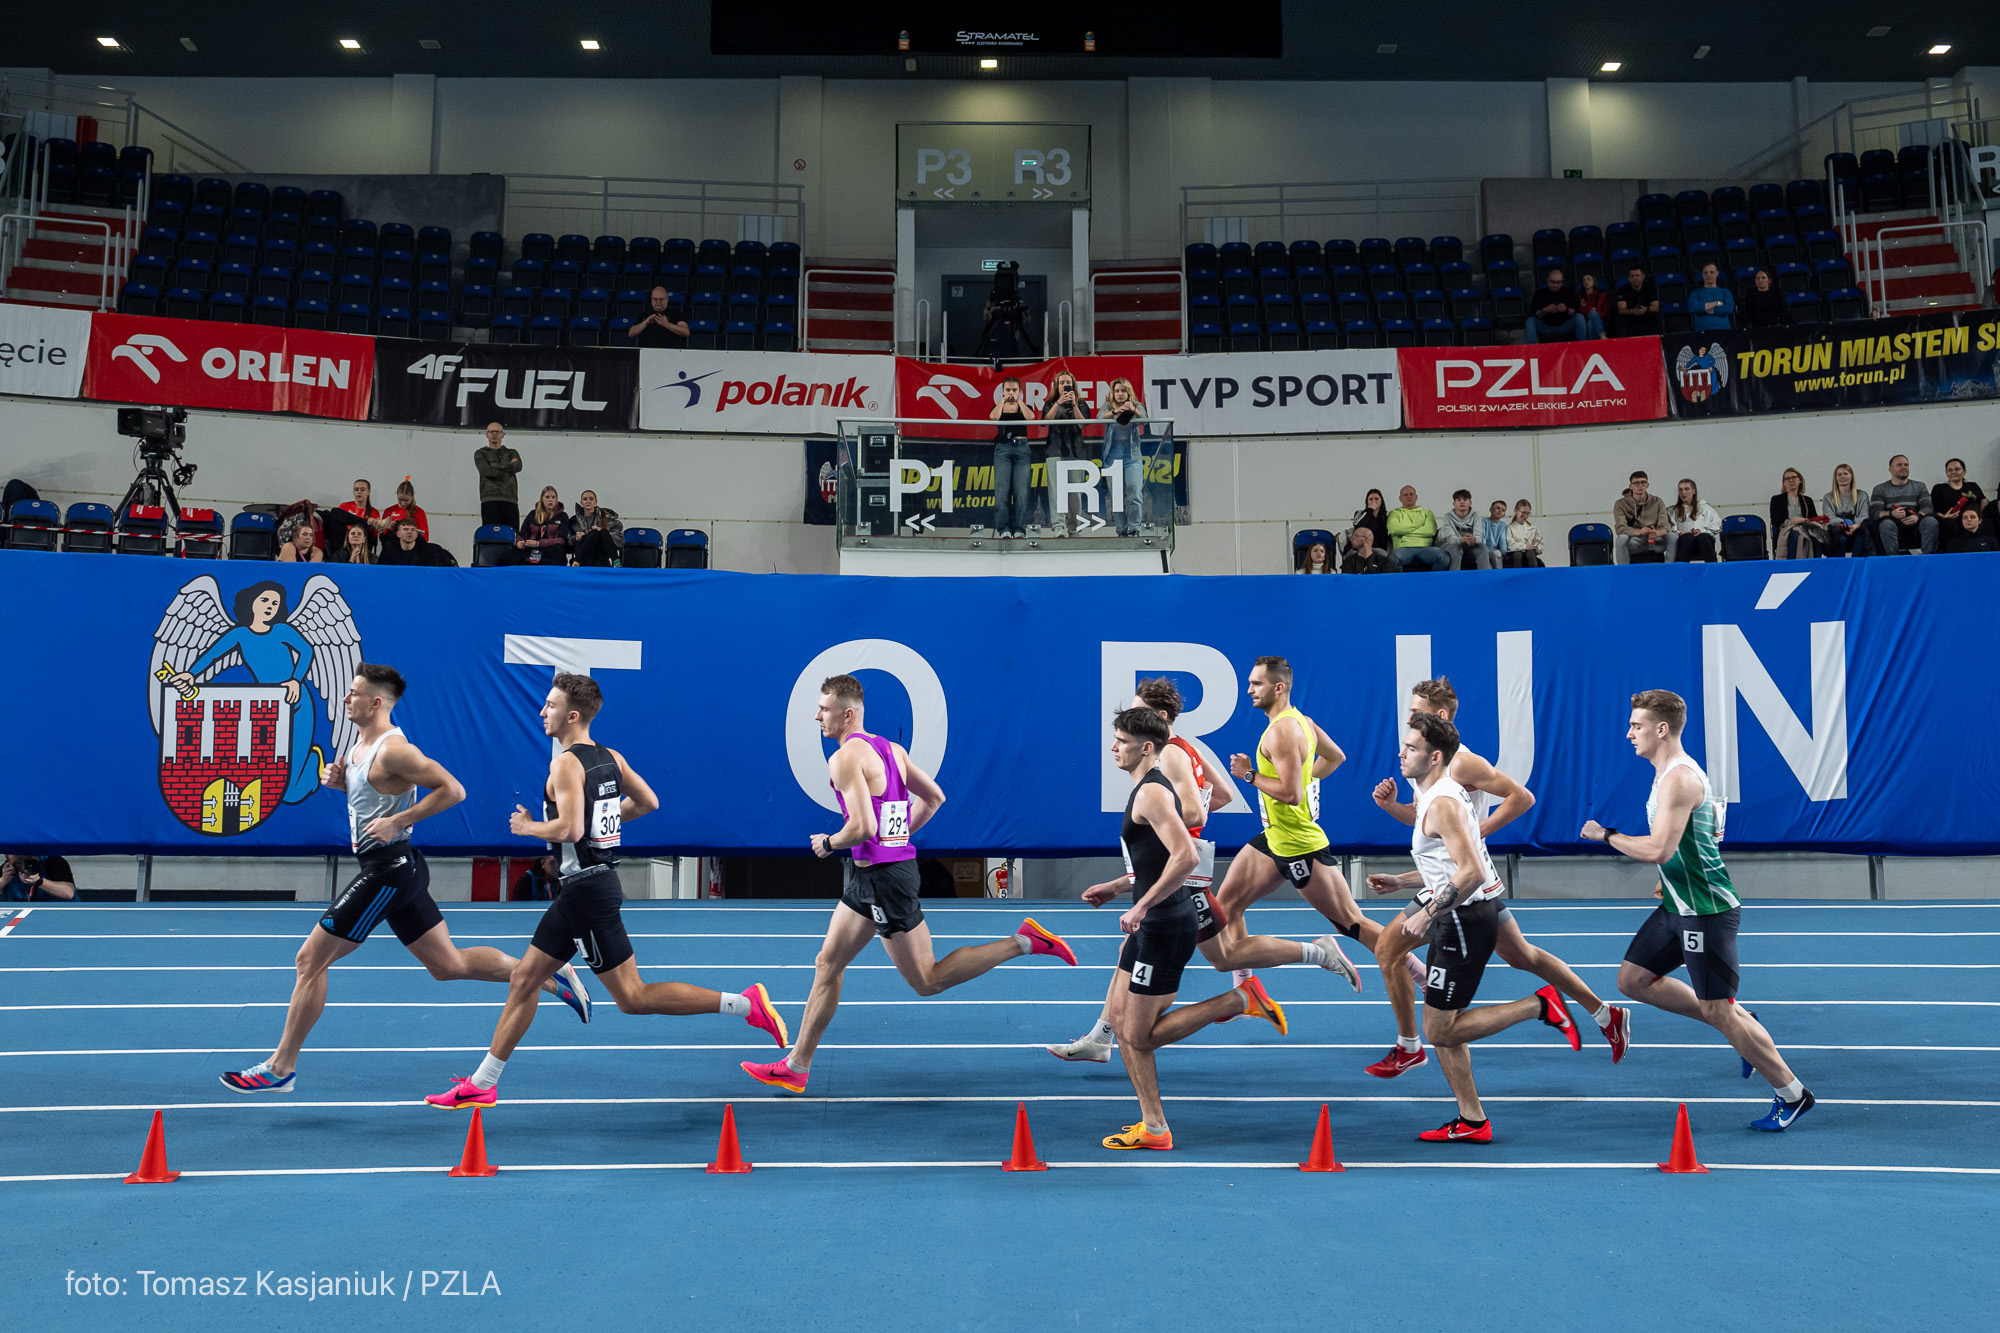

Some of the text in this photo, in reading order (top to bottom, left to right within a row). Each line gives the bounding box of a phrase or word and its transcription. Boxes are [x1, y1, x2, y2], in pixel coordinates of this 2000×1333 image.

[955, 30, 1039, 42] STRAMATEL
[917, 148, 972, 186] P3
[1014, 148, 1072, 186] R3
[201, 347, 351, 389] ORLEN
[1737, 335, 1832, 379] TORUŃ
[1839, 325, 1970, 368] MIASTEM
[407, 353, 608, 411] 4F FUEL
[1151, 372, 1393, 410] TVP SPORT
[1435, 353, 1626, 398] PZLA
[1794, 364, 1906, 393] www.torun.pl
[715, 373, 870, 413] polanik
[1437, 398, 1627, 412] POLSKI ZWIĄZEK LEKKIEJ ATLETYKI
[889, 458, 953, 513] P1
[1056, 459, 1124, 513] R1
[1294, 862, 1305, 877] 8
[1001, 889, 1007, 899] 5
[1192, 895, 1204, 910] 6
[873, 907, 883, 922] 3
[1687, 933, 1699, 950] 5
[1135, 965, 1147, 983] 4
[1430, 968, 1441, 987] 2
